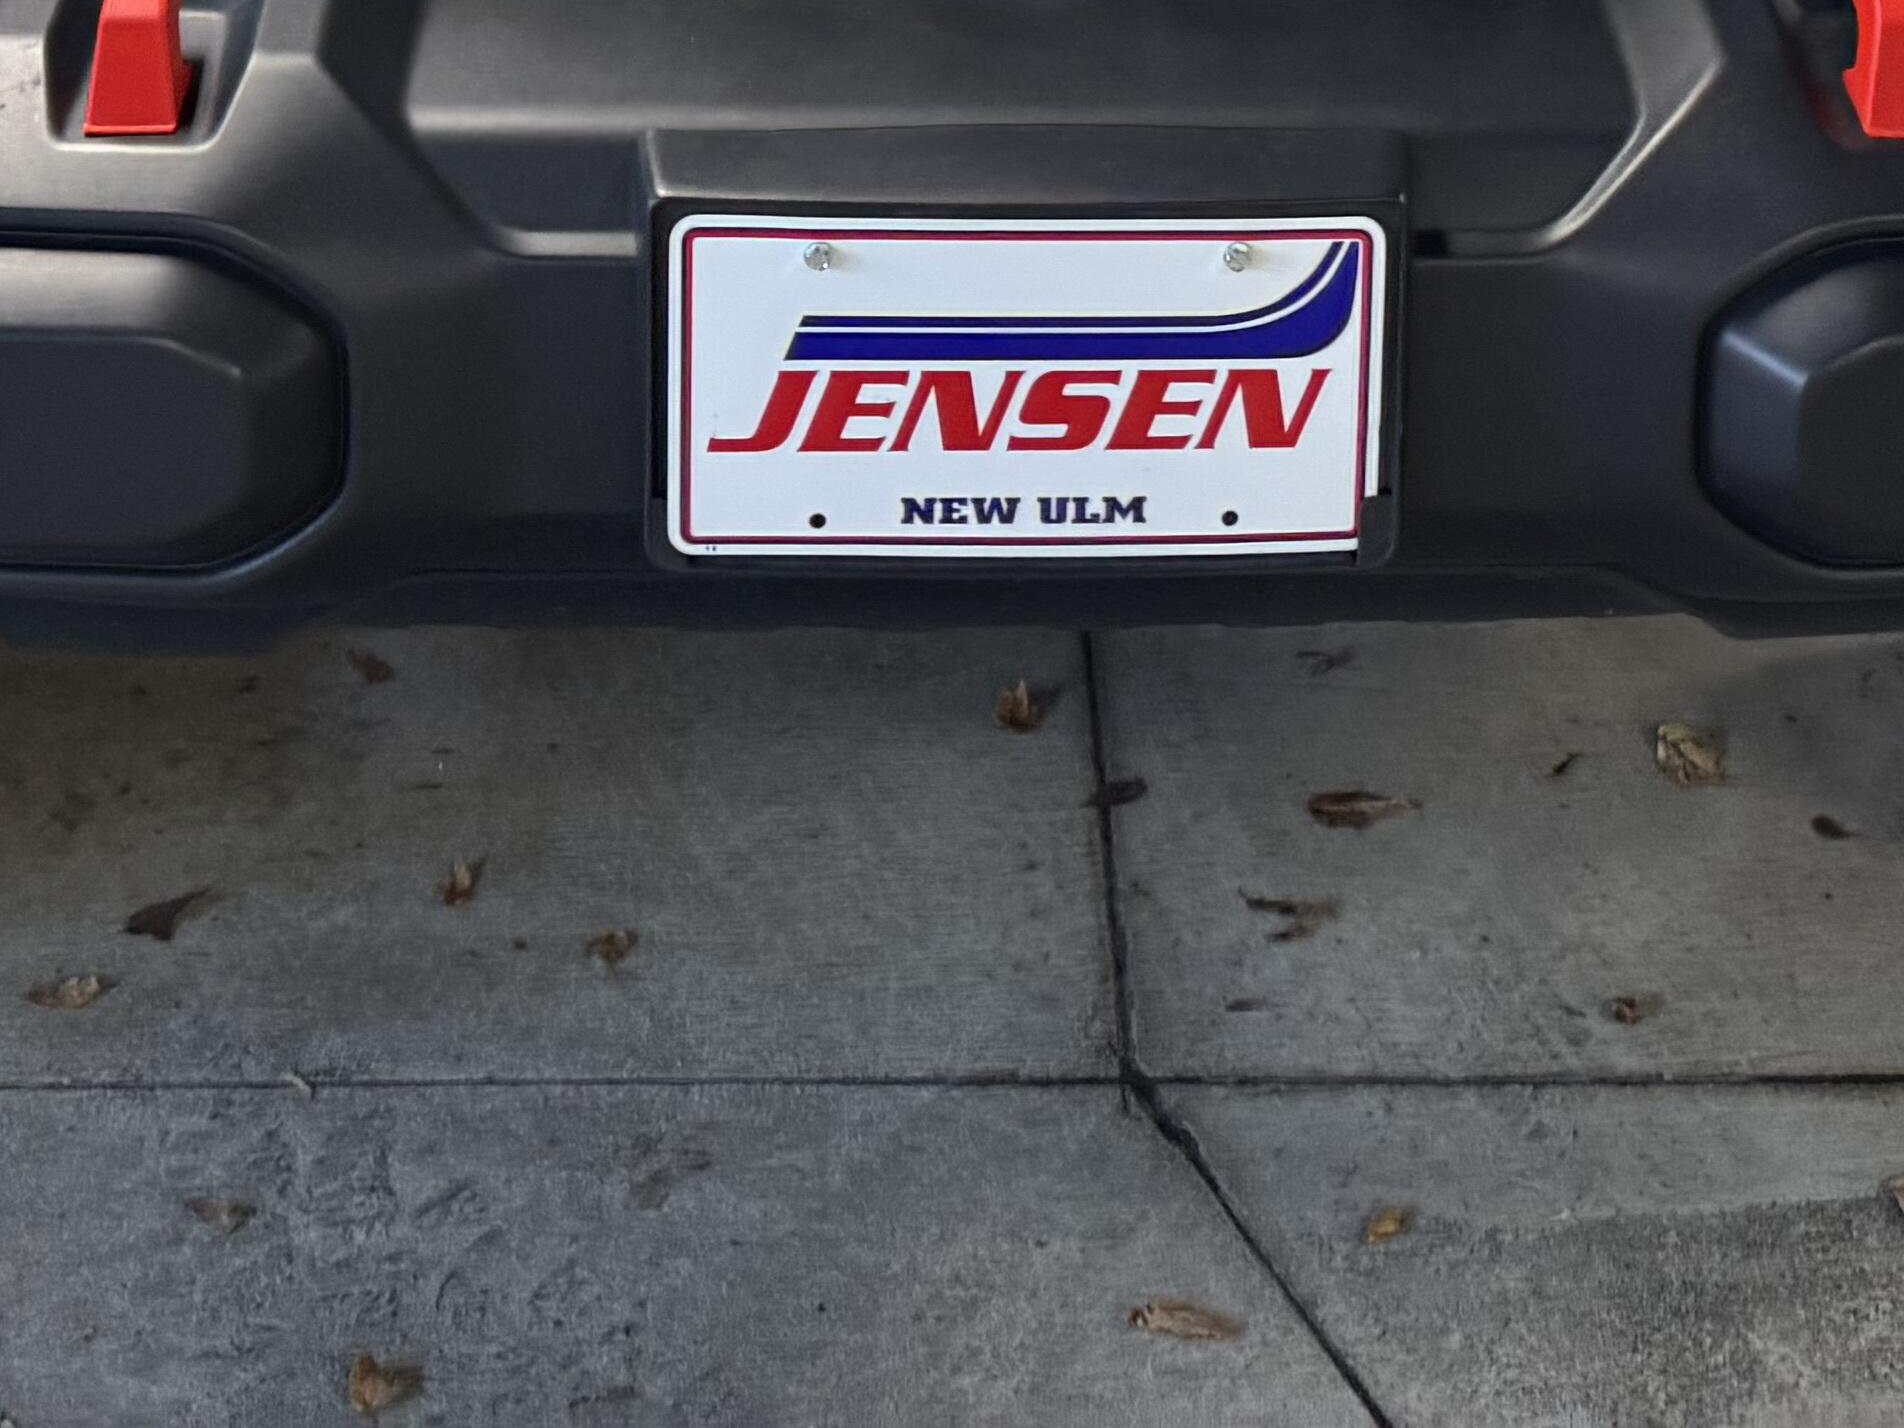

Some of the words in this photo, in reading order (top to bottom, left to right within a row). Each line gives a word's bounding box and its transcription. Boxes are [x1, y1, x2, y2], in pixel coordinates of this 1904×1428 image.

[707, 368, 1332, 453] JENSEN
[900, 496, 1021, 525] NEW
[1036, 495, 1148, 524] ULM
